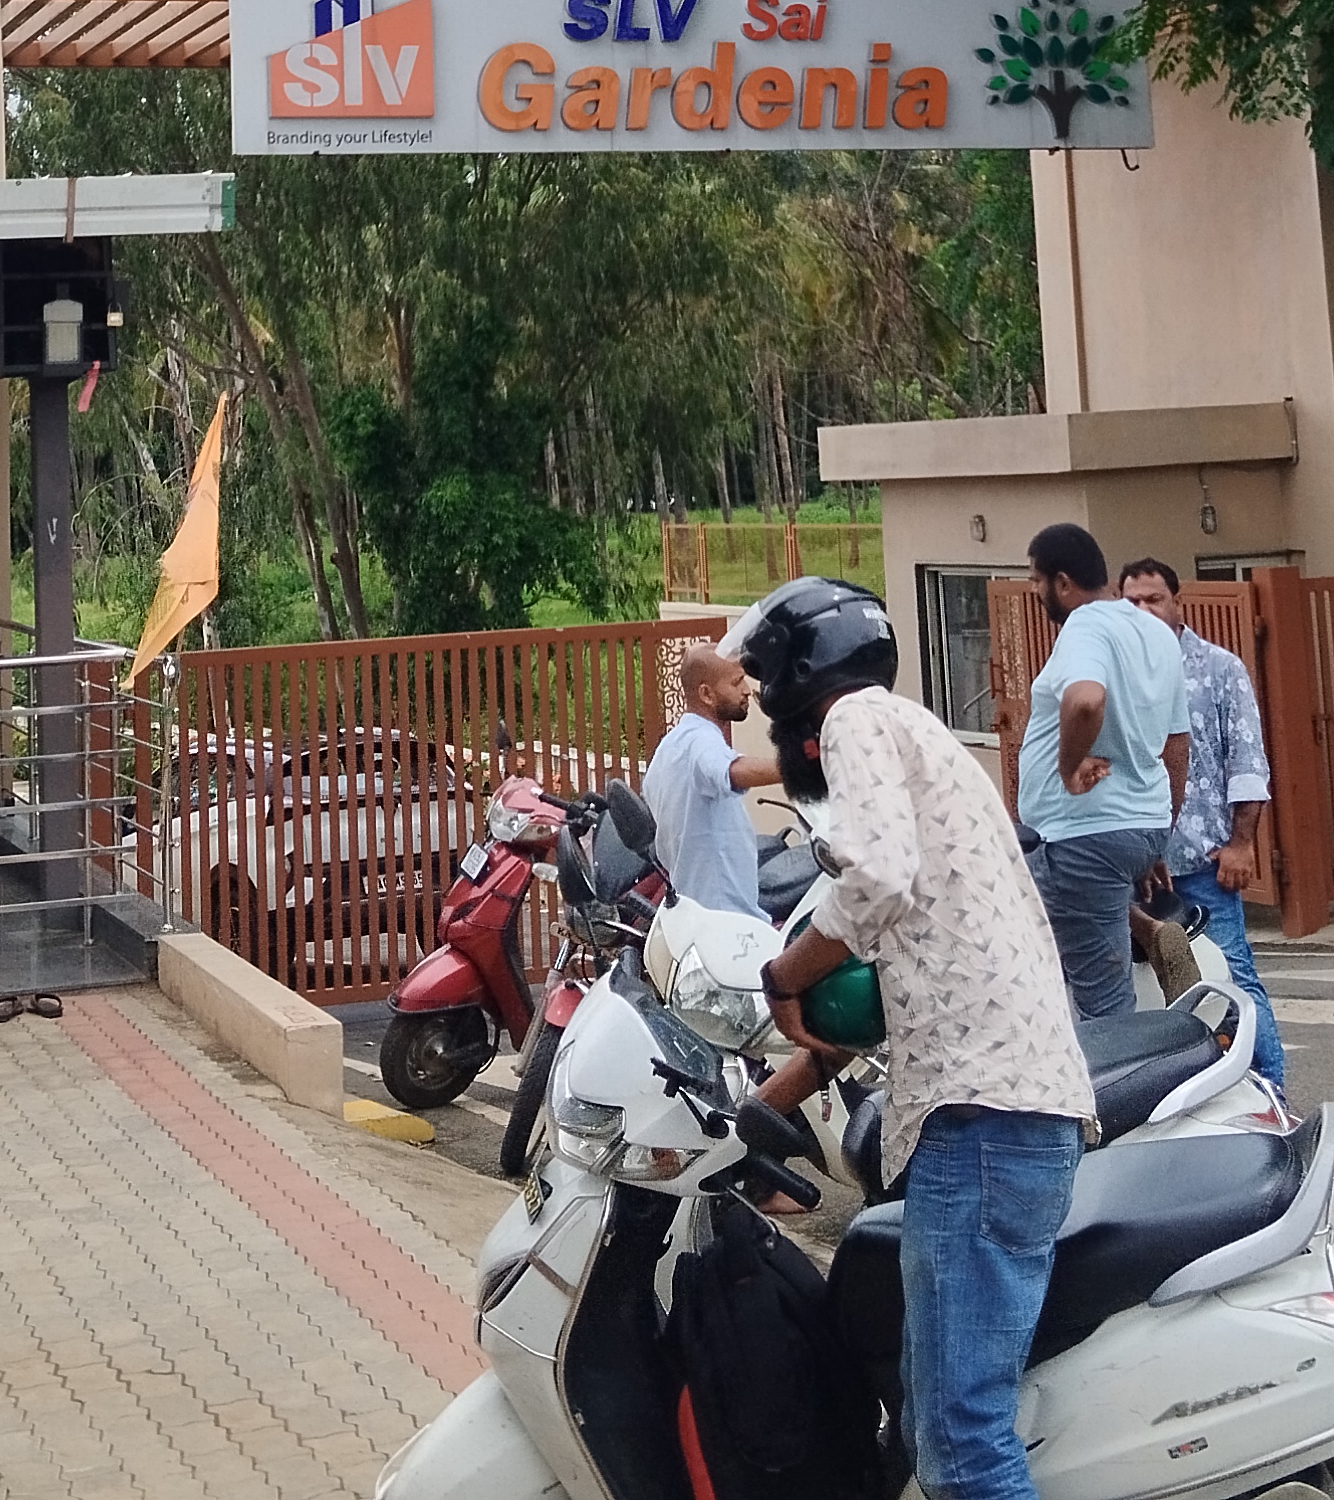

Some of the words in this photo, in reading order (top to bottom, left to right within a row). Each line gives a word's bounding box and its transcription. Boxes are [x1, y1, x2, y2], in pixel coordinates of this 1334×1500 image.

[478, 41, 949, 132] Gardenia
[267, 131, 332, 148] Branding
[336, 134, 368, 148] your
[371, 129, 433, 147] Lifestyle!
